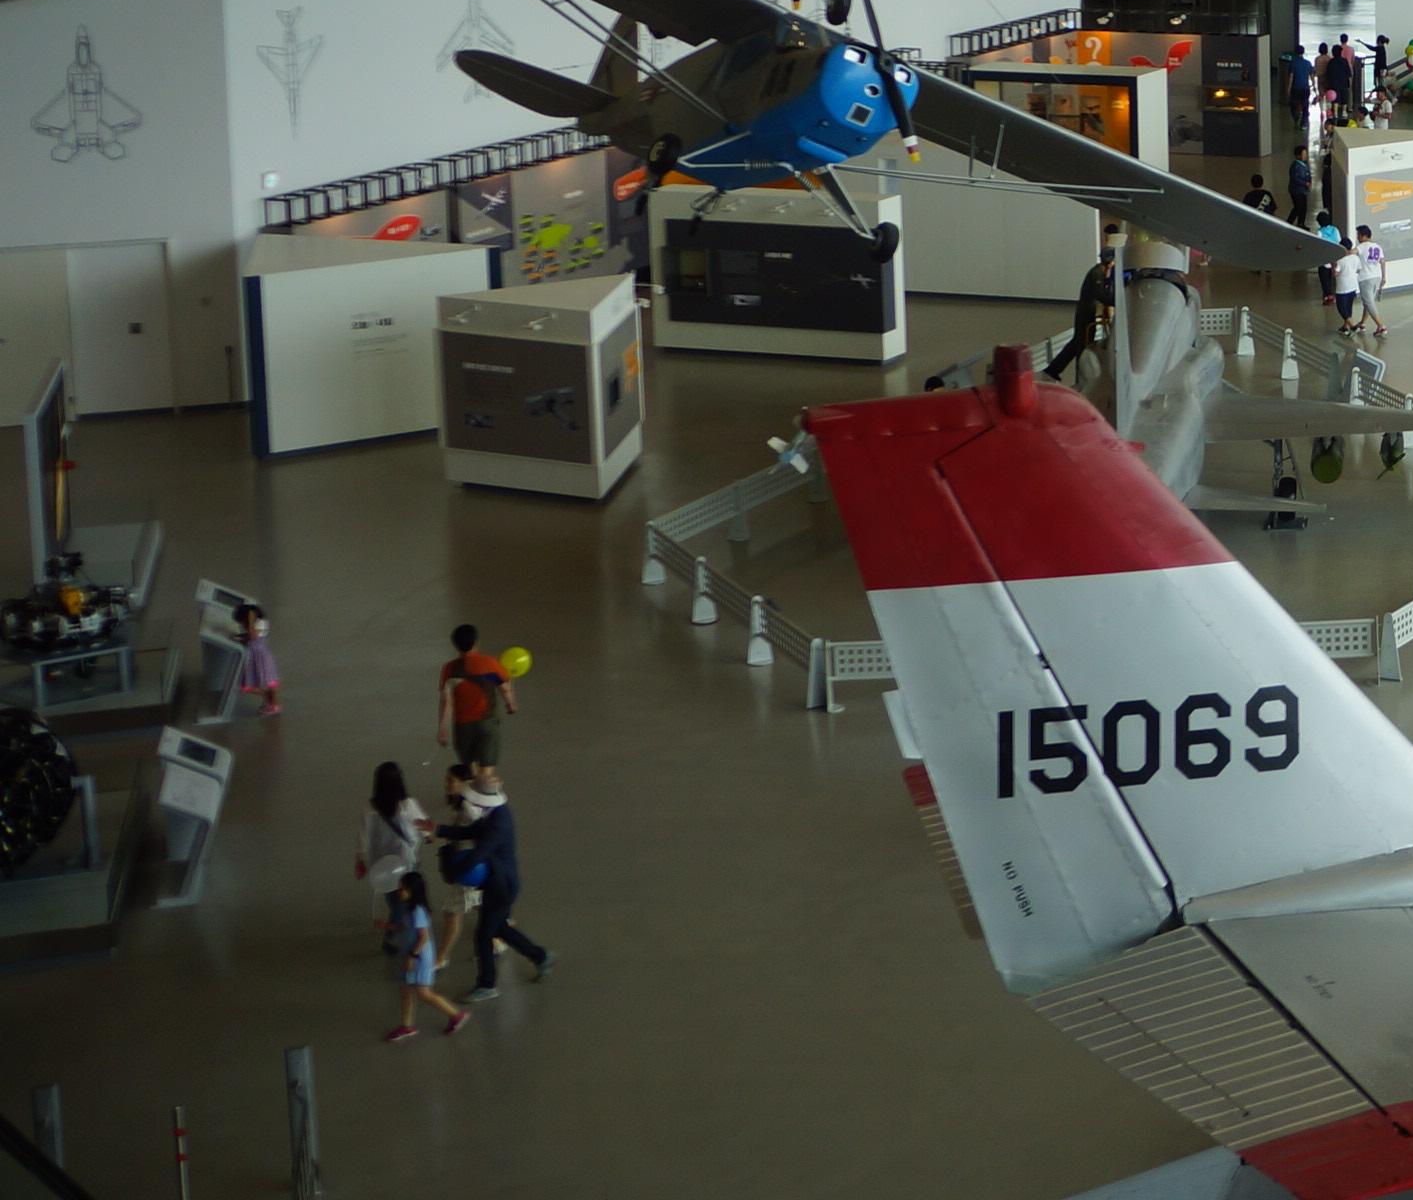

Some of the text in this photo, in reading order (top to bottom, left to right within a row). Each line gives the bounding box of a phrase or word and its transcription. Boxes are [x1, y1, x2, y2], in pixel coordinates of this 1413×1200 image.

[996, 684, 1301, 799] 15069
[1001, 860, 1034, 918] NO PUSH
